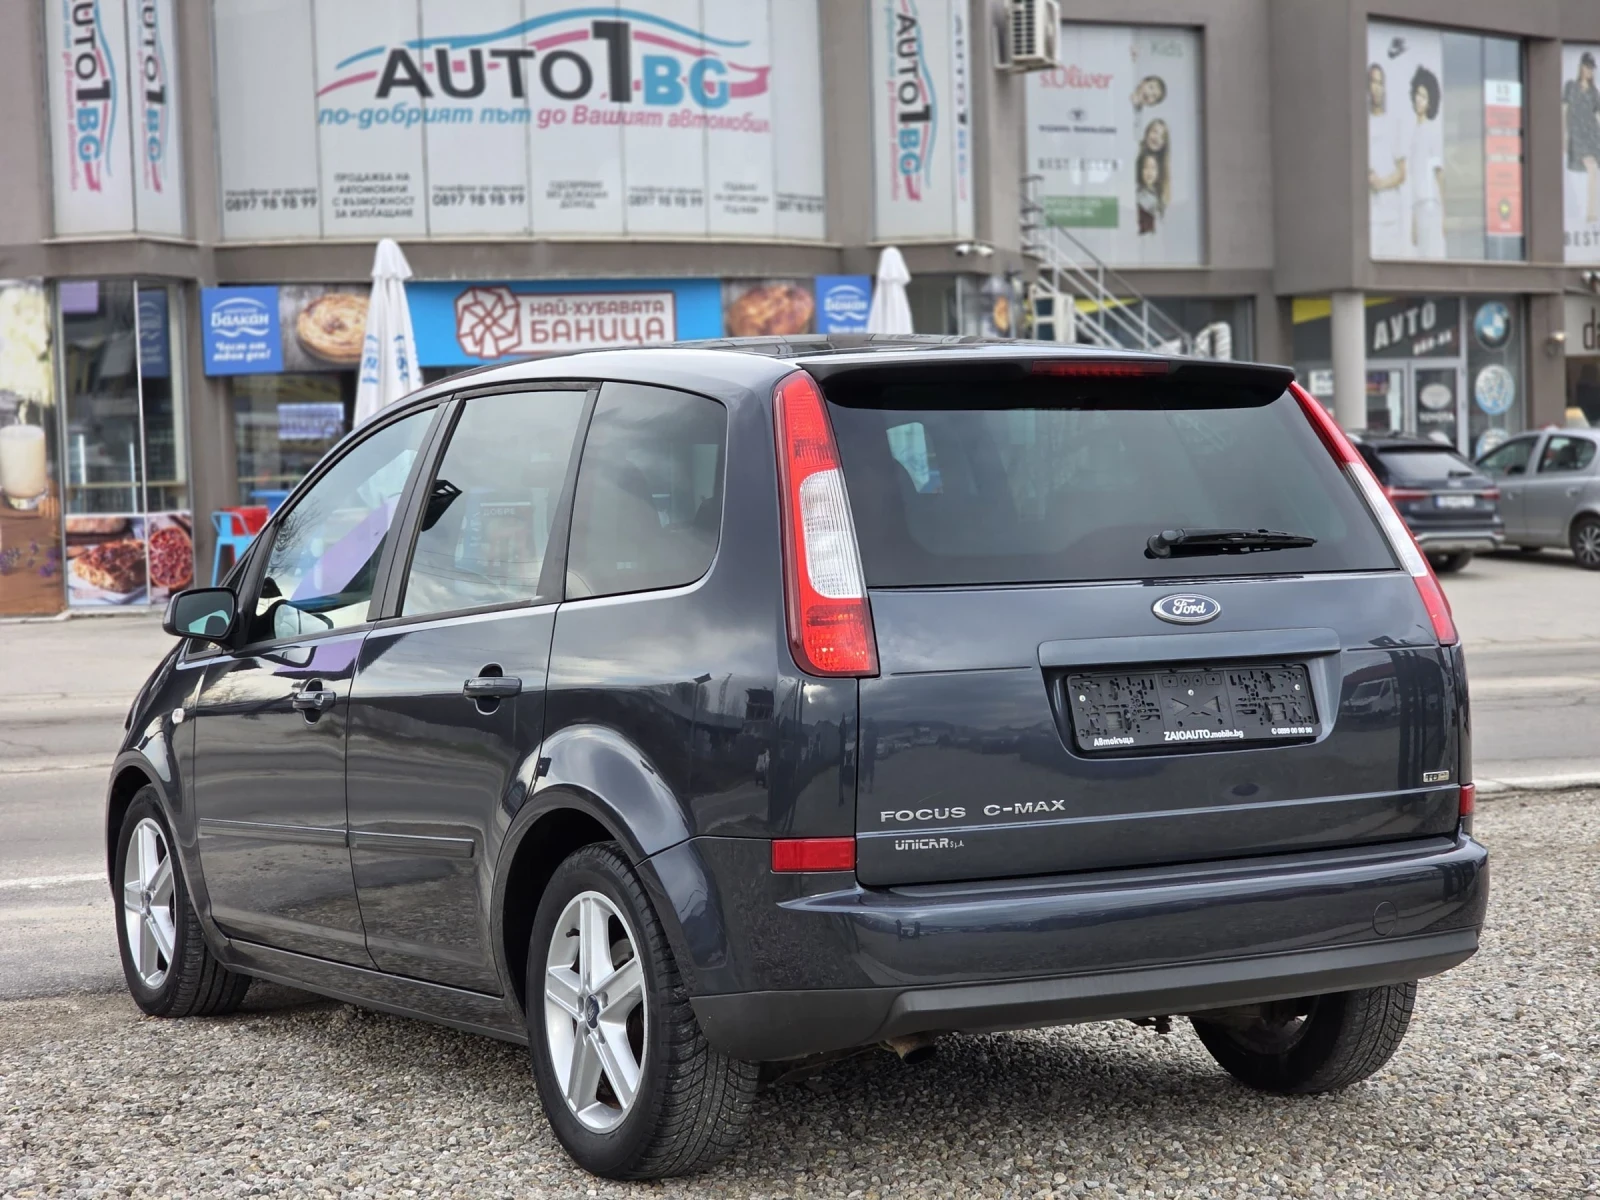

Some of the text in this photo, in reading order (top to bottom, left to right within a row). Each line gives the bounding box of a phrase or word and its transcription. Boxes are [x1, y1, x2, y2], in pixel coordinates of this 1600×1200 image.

[72, 0, 111, 163] UTO1BG
[141, 0, 167, 164] UTO1BG
[318, 102, 770, 133] по-добрият път до Вашият автомобил
[529, 299, 665, 316] НАЙ-ХУБАВАТА
[530, 317, 665, 344] БАНИЦА
[1172, 598, 1207, 615] Ford
[880, 799, 1067, 823] FOCUS C-MAX
